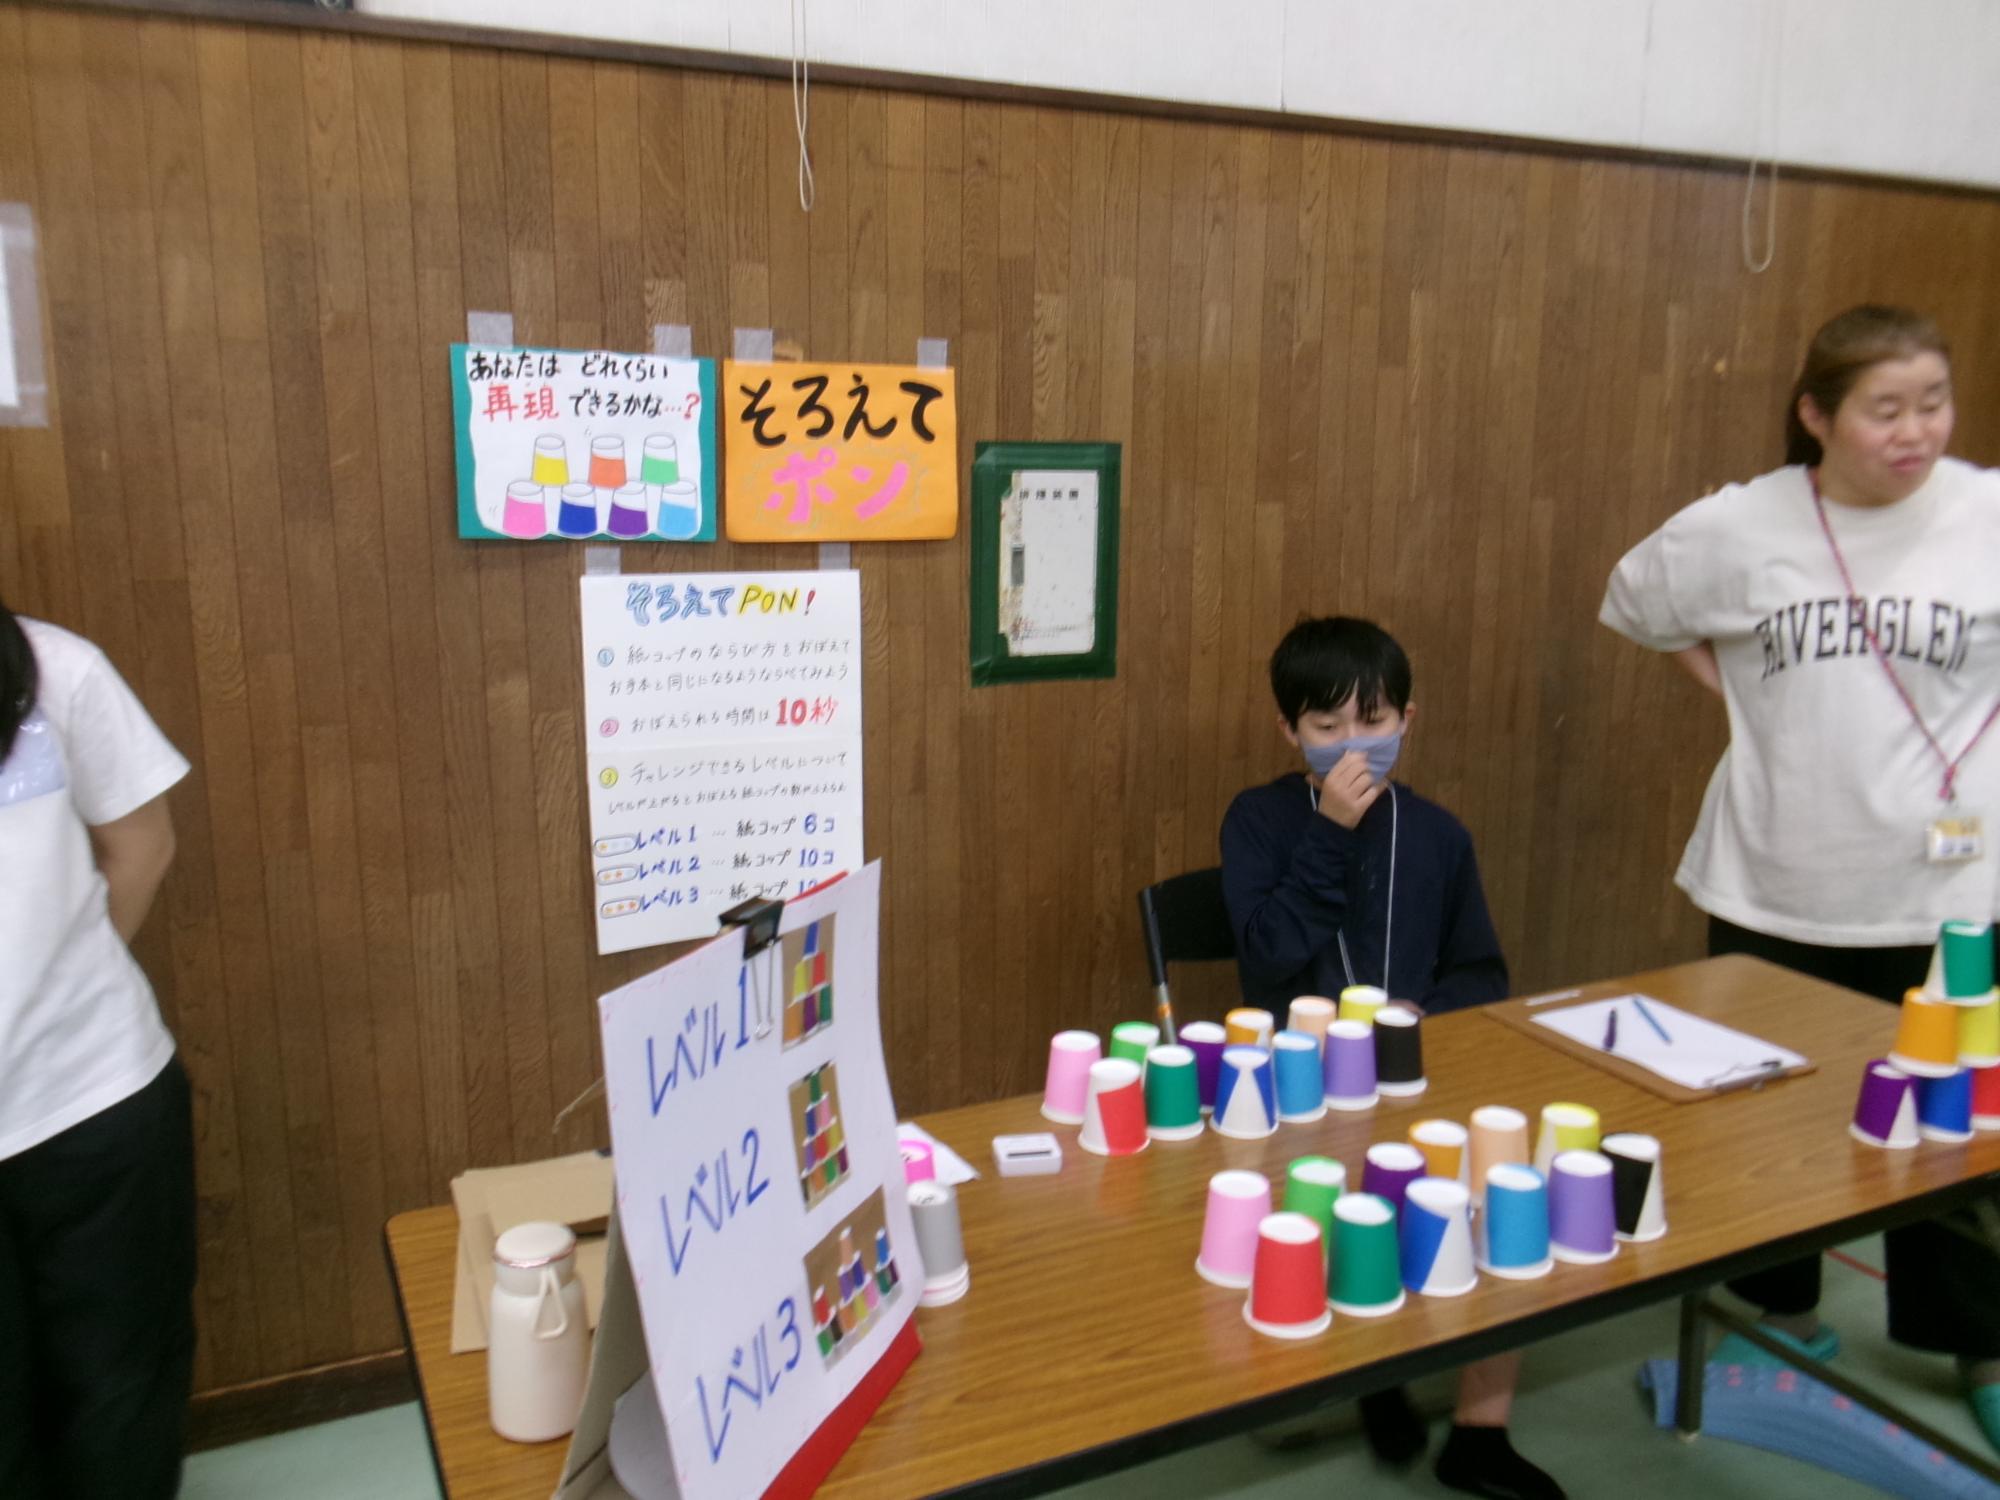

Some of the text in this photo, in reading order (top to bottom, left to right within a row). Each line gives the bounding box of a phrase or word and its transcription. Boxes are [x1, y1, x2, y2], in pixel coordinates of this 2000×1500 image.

[469, 350, 668, 383] あなたは どれくらい
[482, 384, 560, 422] 再現
[739, 373, 944, 447] そろえて
[764, 446, 910, 525] ポン
[626, 581, 736, 627] そろえて
[1754, 597, 1977, 682] RIVERGLEN
